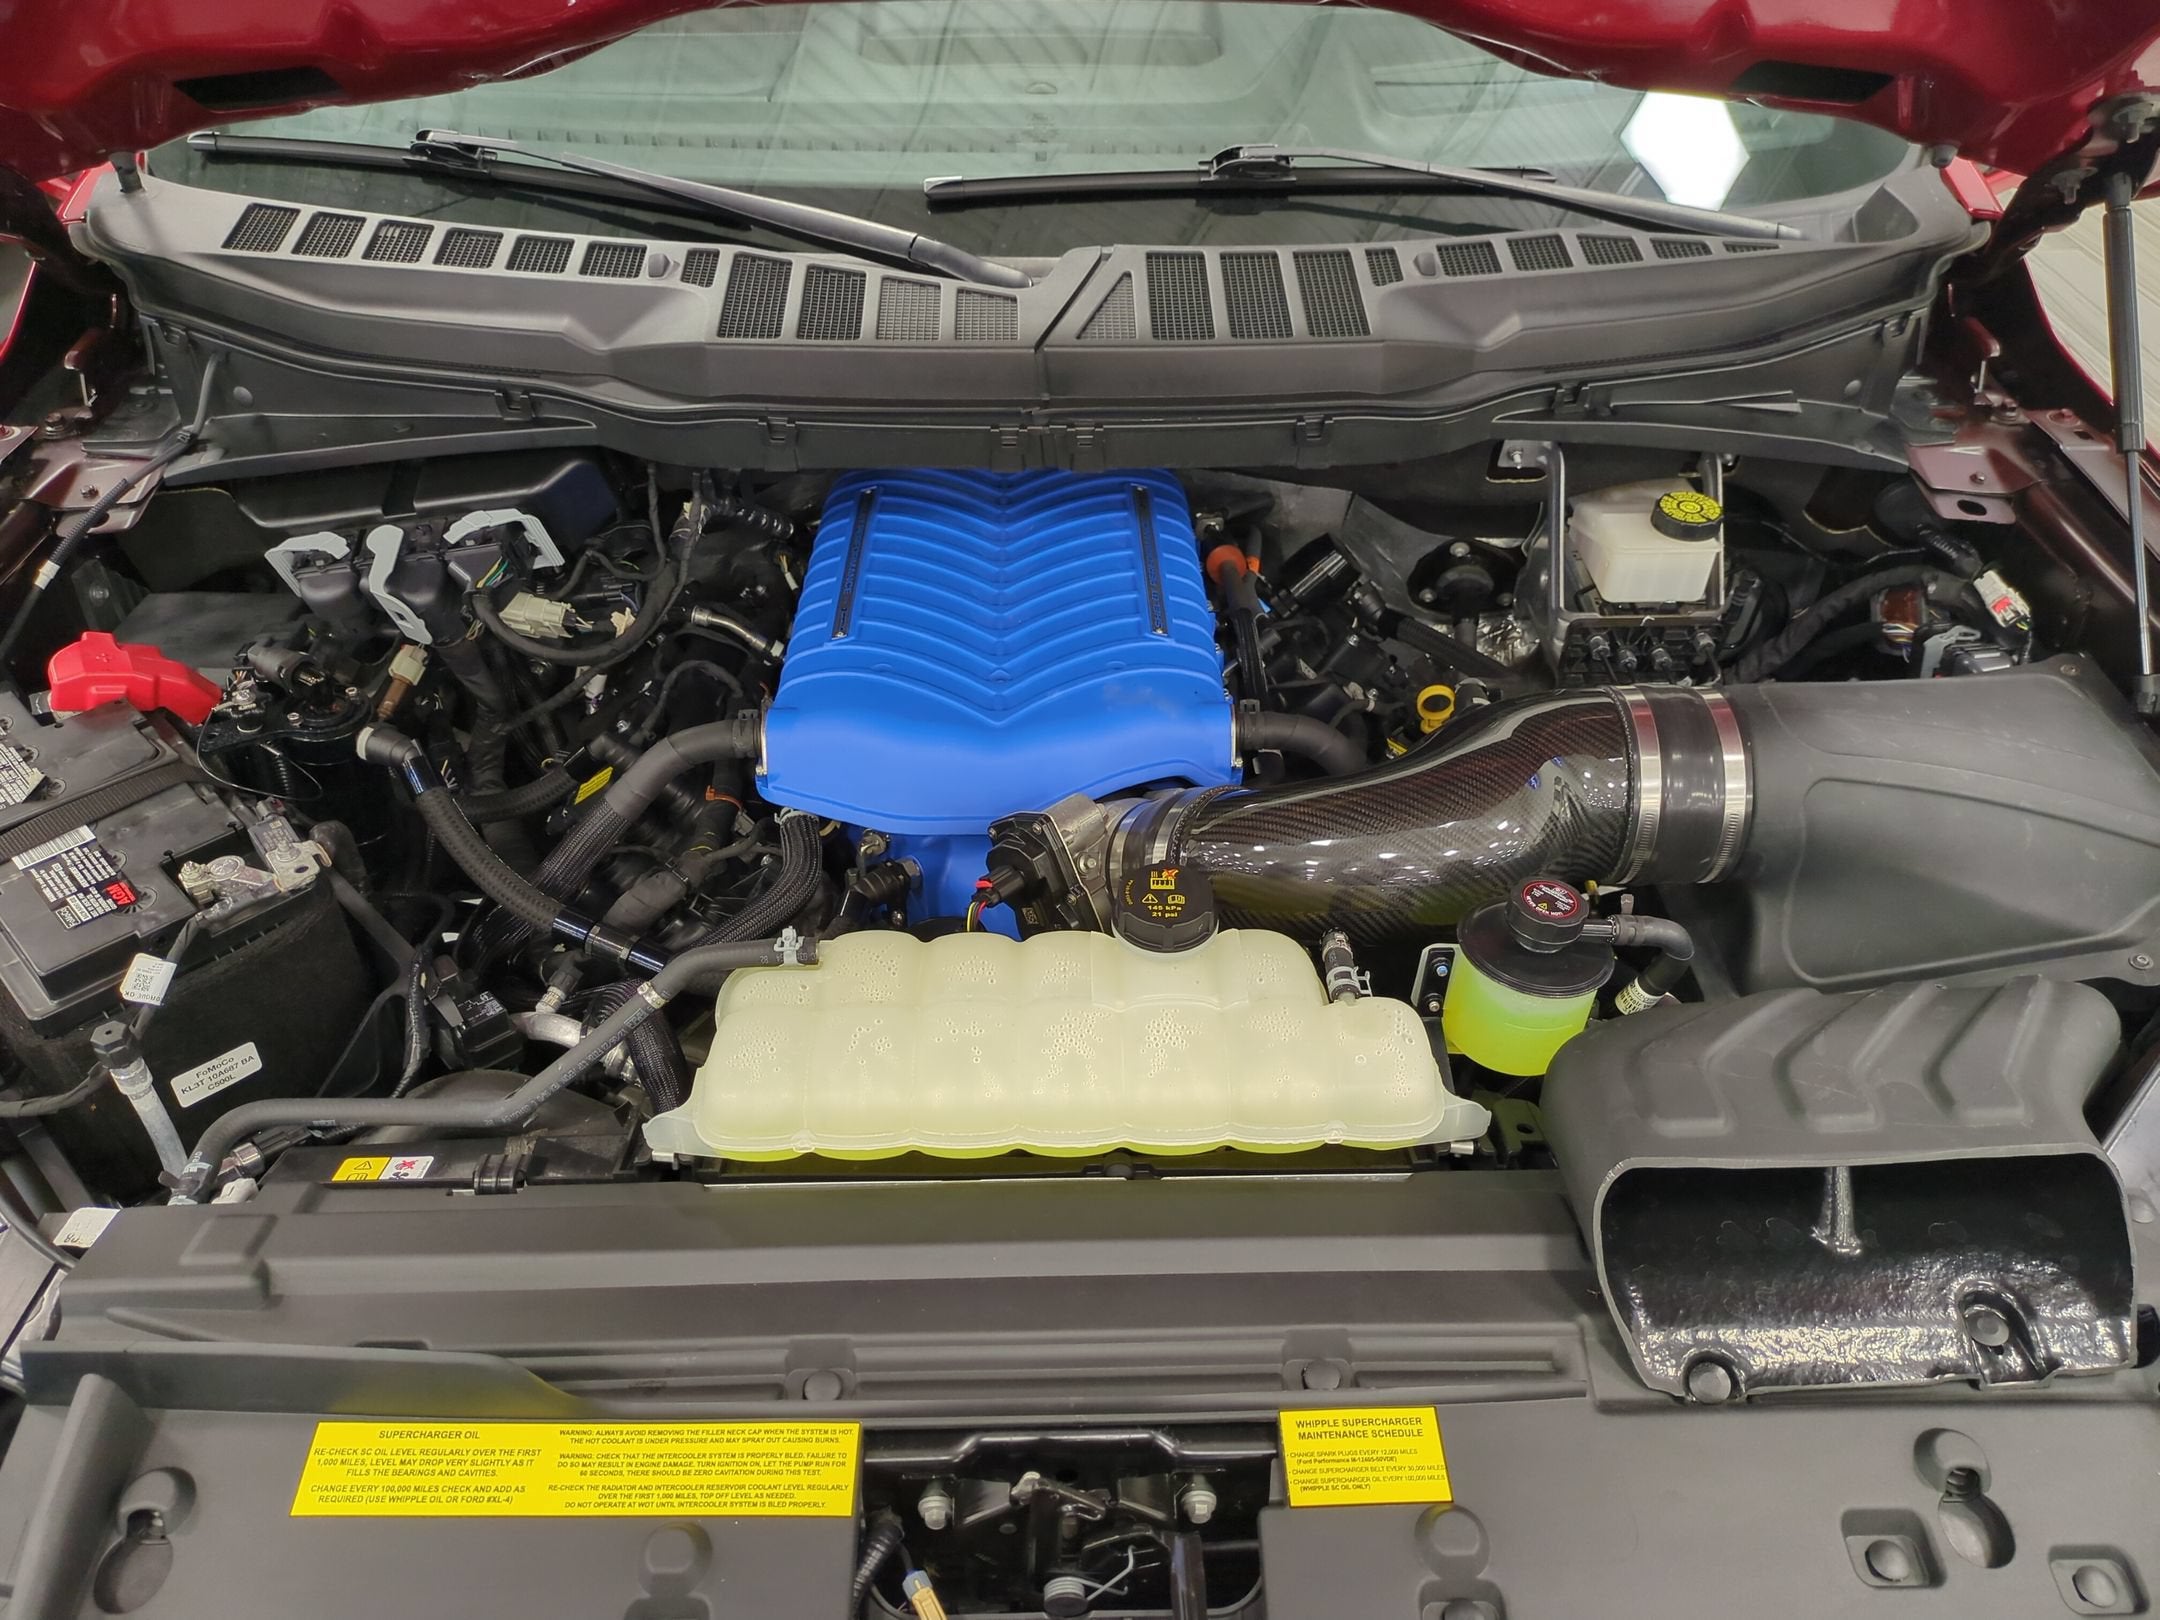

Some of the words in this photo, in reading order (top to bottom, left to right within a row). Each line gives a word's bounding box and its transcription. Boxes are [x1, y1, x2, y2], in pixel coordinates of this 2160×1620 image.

[196, 1057, 234, 1078] FoMoCo
[181, 1080, 206, 1094] KL3T
[208, 1063, 239, 1082] 10A687
[241, 1055, 254, 1065] BA
[207, 1075, 236, 1090] C500L
[1295, 1420, 1338, 1428] WHIPPLE
[1342, 1418, 1421, 1427] SUPERCHARGER
[378, 1431, 462, 1439] SUPERCHARGER
[463, 1431, 480, 1439] OIL
[1298, 1431, 1368, 1440] MAINTENANCE
[1371, 1429, 1423, 1438] SCHEDULE
[313, 1448, 358, 1456] RE-CHECK
[360, 1448, 372, 1456] SC
[373, 1448, 388, 1456] OIL
[369, 1458, 397, 1466] LEVEL
[399, 1458, 417, 1466] MAY
[418, 1458, 443, 1466] DROP
[445, 1458, 468, 1466] VERY
[469, 1458, 510, 1466] SLIGHTLY
[512, 1458, 524, 1466] AS
[526, 1458, 533, 1466] IT
[346, 1469, 370, 1477] FILLS
[372, 1469, 389, 1477] THE
[391, 1469, 435, 1477] BEARINGS
[437, 1469, 456, 1477] AND
[310, 1485, 347, 1493] CHANGE
[349, 1485, 378, 1493] EVERY
[412, 1485, 439, 1493] MILES
[441, 1485, 471, 1493] CHECK
[472, 1485, 491, 1493] AND
[493, 1485, 512, 1493] ADD
[513, 1485, 525, 1493] AS
[318, 1496, 363, 1504] REQUIRED
[365, 1496, 386, 1504] (USE
[387, 1496, 427, 1504] WHIPPLE
[428, 1496, 443, 1504] OIL
[445, 1496, 458, 1504] OR
[460, 1496, 485, 1504] FORD
